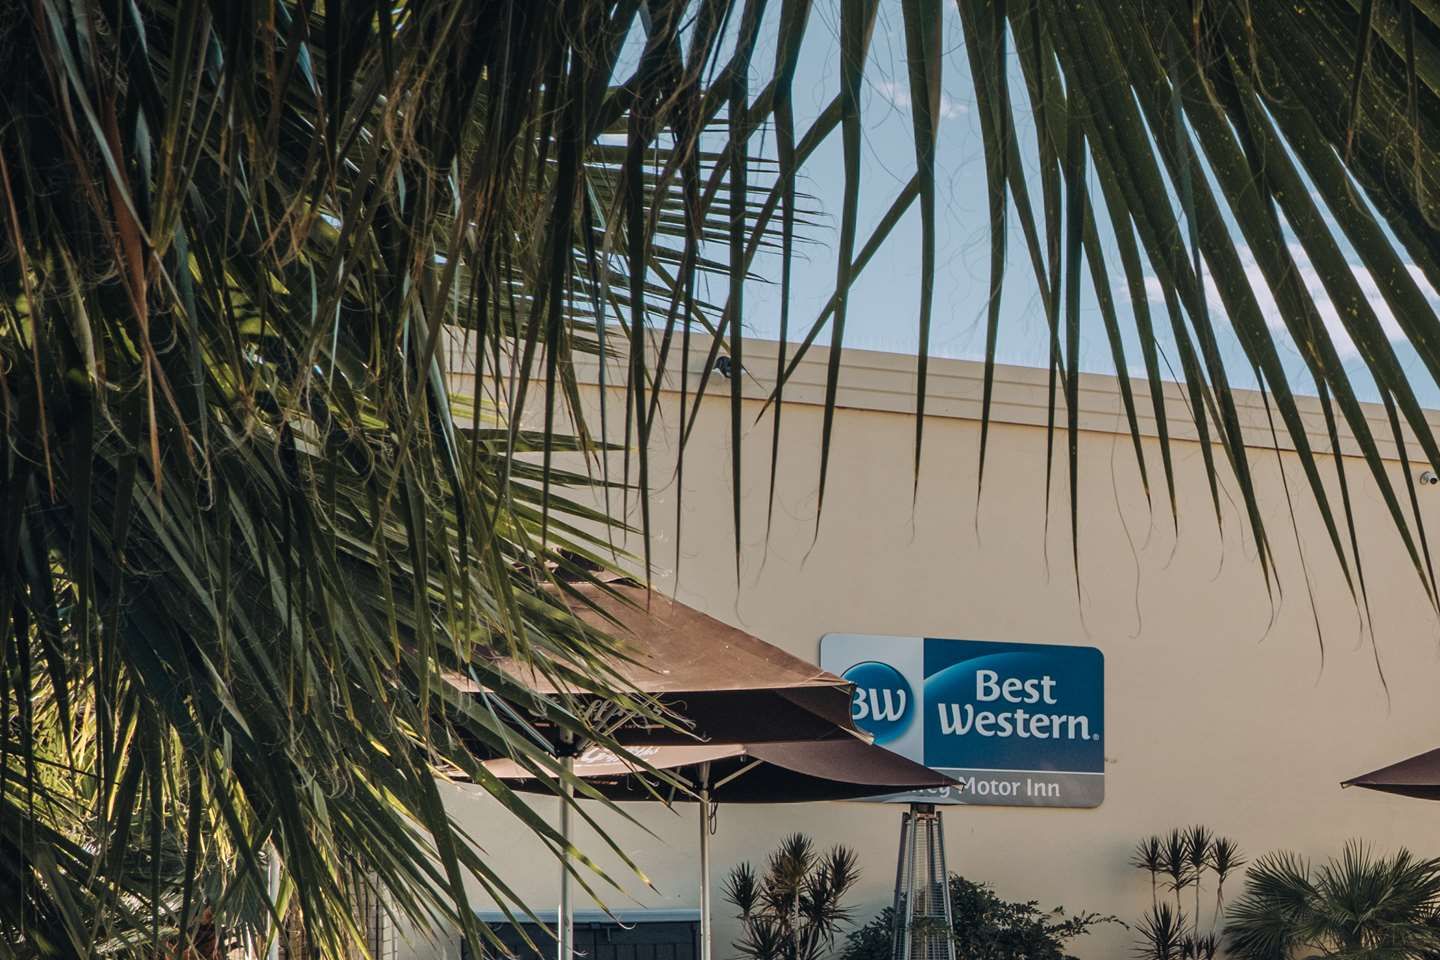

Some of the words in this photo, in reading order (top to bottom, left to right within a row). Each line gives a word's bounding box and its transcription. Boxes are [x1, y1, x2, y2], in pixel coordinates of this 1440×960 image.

[976, 669, 1057, 704] Best
[852, 687, 906, 721] BW
[938, 703, 1091, 740] Western
[958, 776, 1021, 796] Motor
[1027, 778, 1061, 797] Inn
